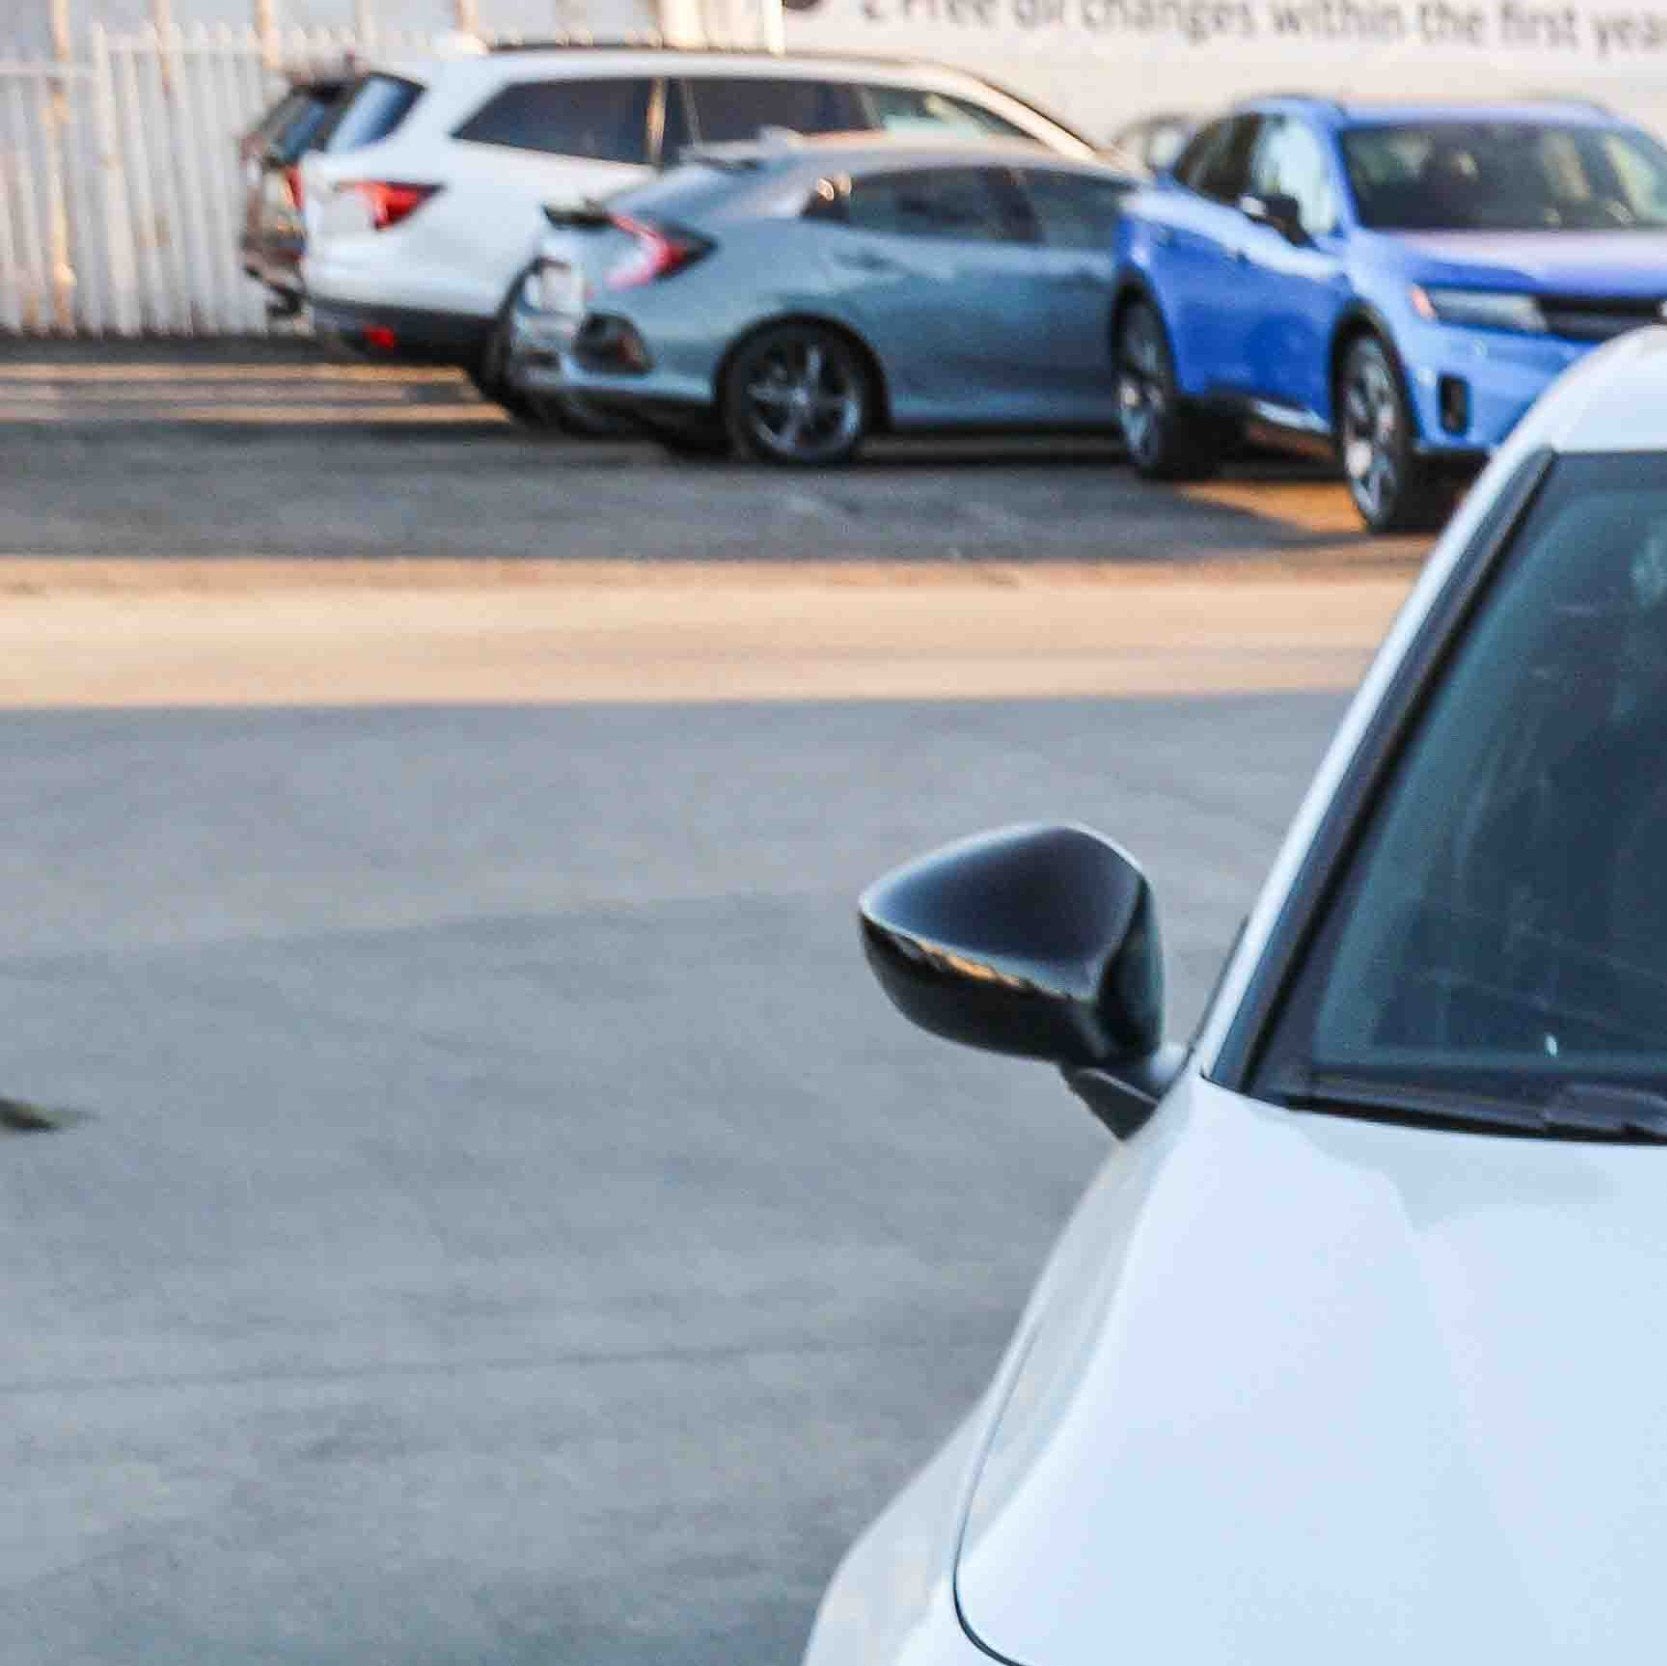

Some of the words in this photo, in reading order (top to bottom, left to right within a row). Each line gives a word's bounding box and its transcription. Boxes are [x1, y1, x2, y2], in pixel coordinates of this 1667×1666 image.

[1080, 0, 1254, 43] changes
[1270, 0, 1403, 40] within
[1417, 0, 1486, 45] the
[1499, 1, 1580, 51] first
